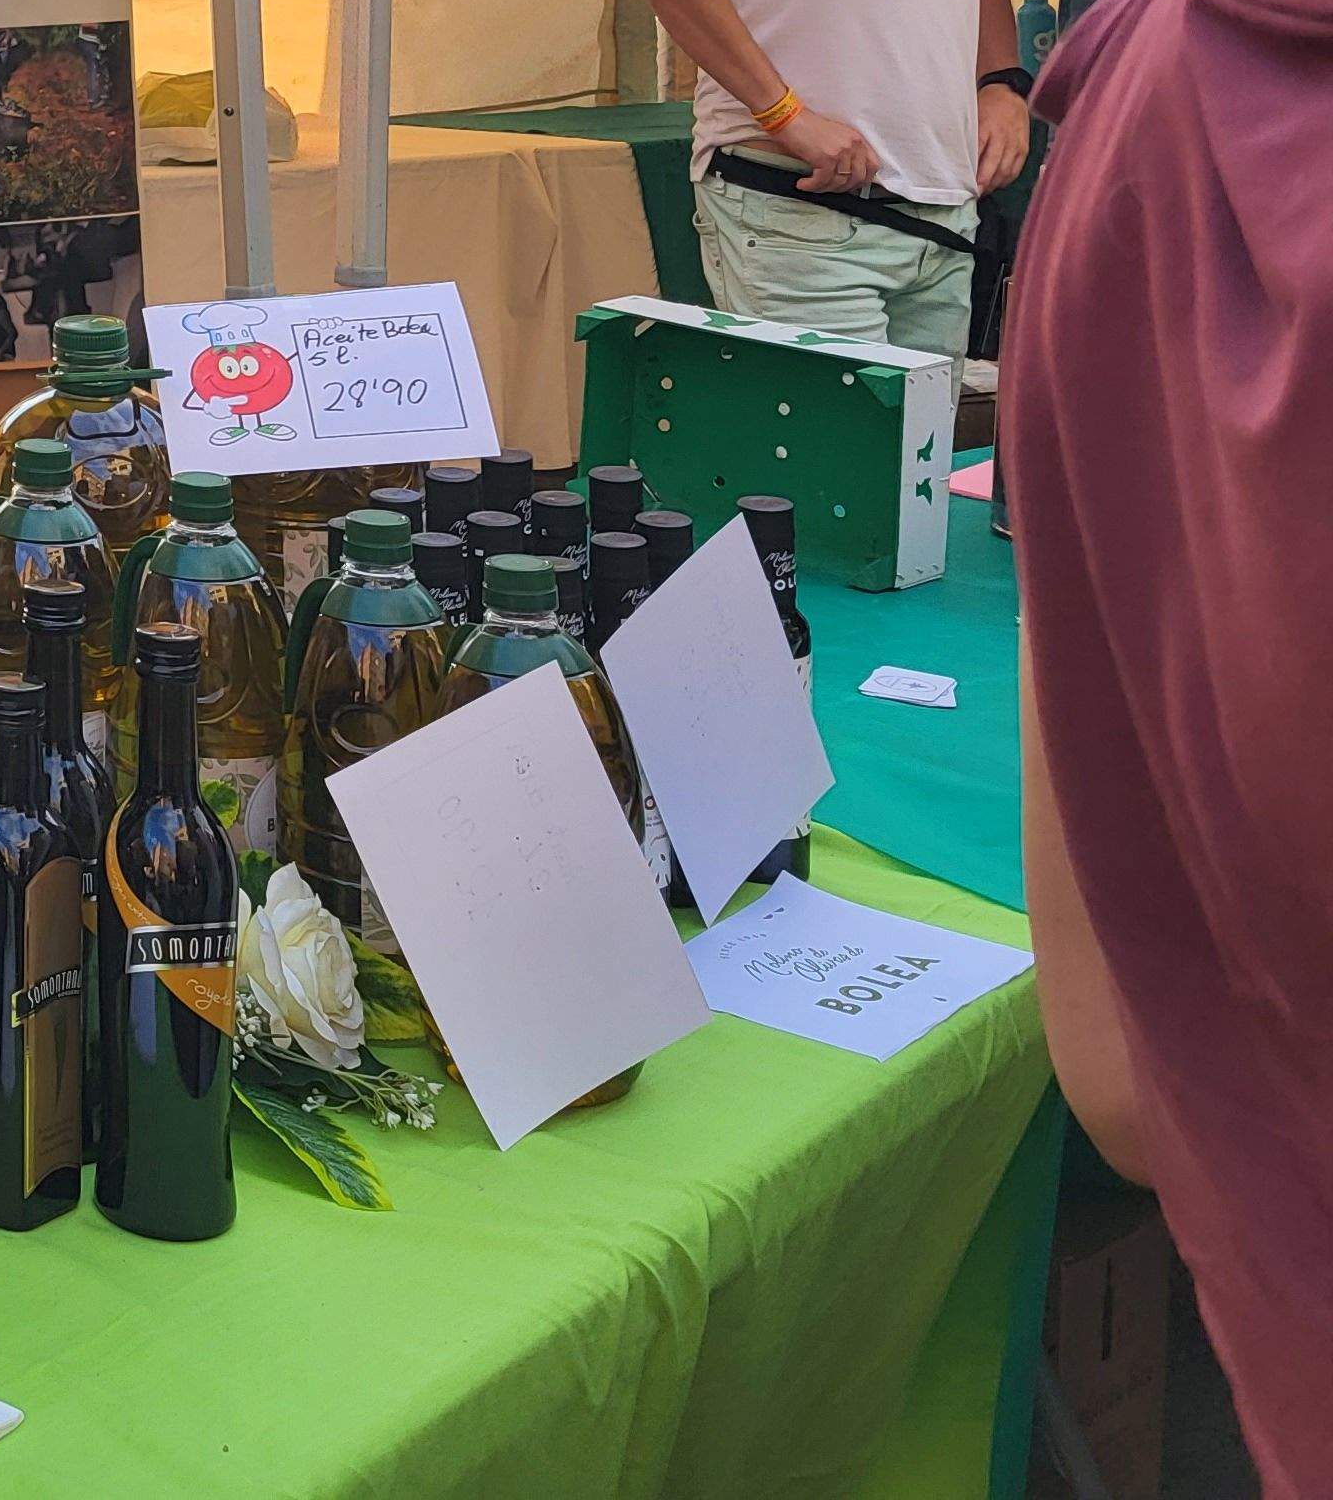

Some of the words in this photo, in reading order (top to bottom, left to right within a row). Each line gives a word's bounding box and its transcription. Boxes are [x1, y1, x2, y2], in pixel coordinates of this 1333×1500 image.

[303, 322, 380, 350] Aceite
[308, 350, 329, 367] 5
[323, 378, 428, 412] 28'90
[137, 932, 238, 962] SOMONTA
[815, 955, 942, 1016] BOLEA
